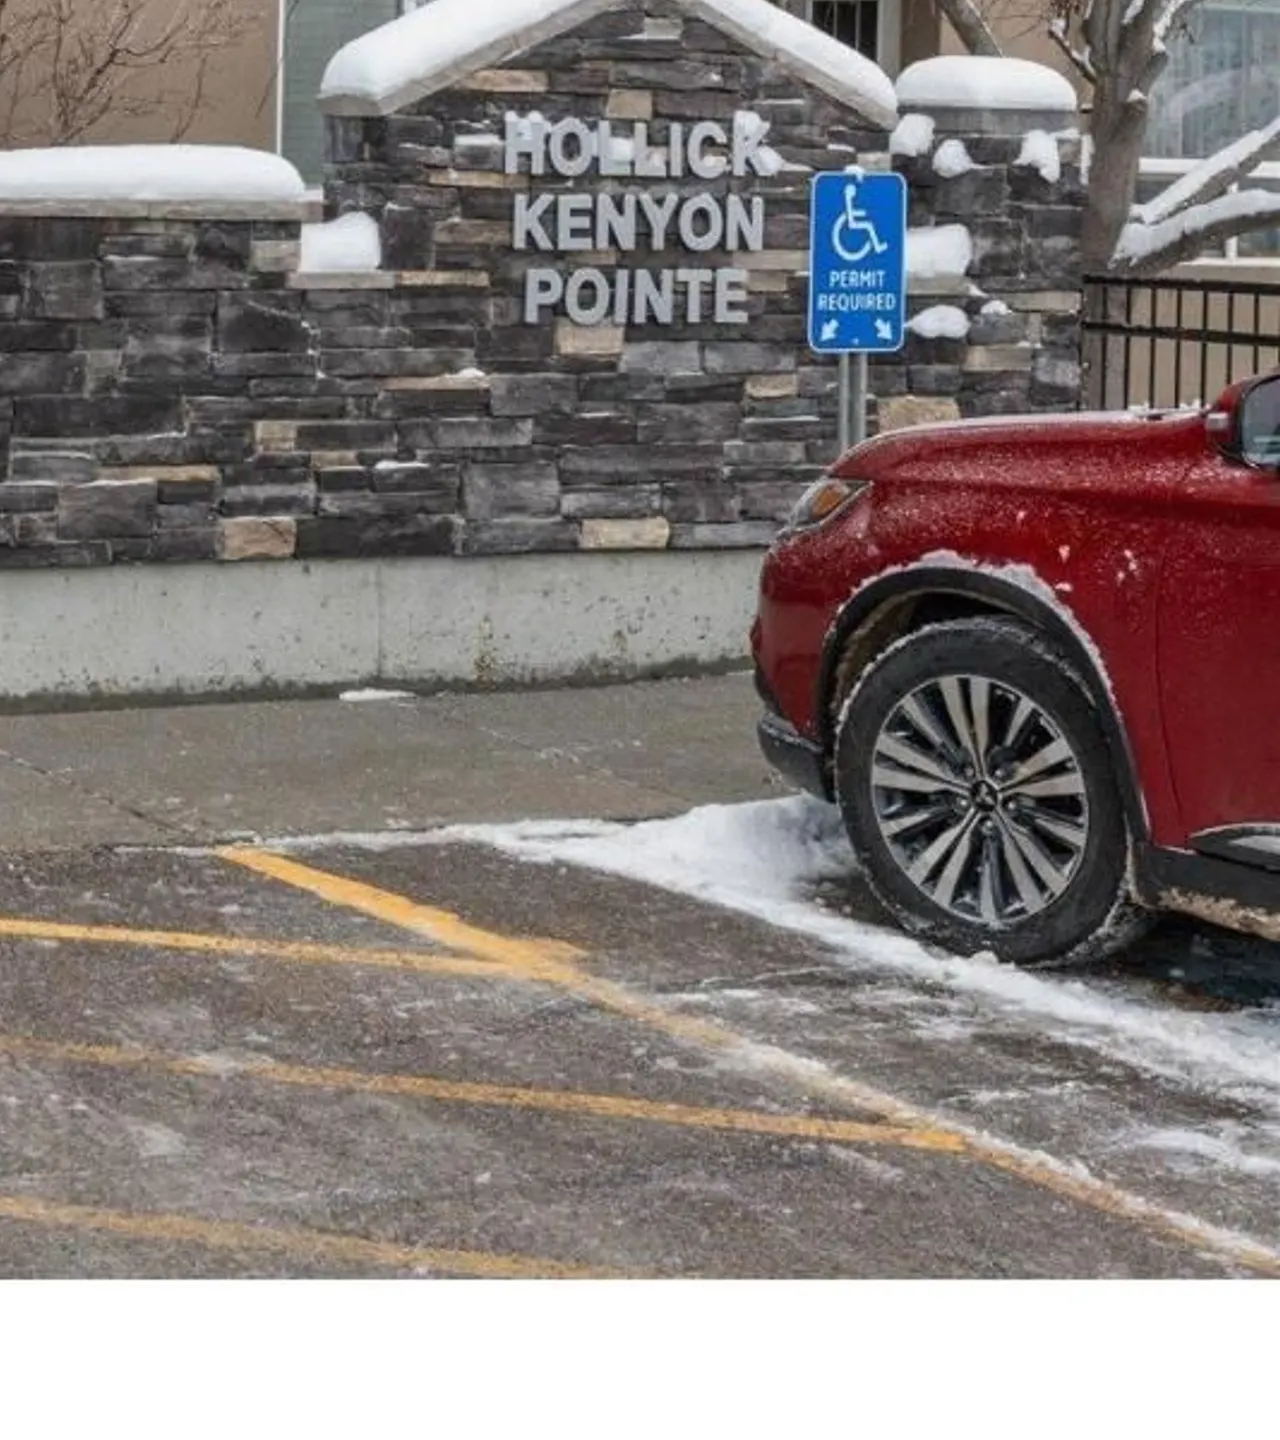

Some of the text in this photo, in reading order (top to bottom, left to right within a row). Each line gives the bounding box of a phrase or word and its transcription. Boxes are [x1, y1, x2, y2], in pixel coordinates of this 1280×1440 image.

[504, 111, 781, 179] HOLLICK
[513, 192, 765, 252] KENYON
[524, 267, 750, 327] POINTE
[817, 292, 897, 313] REQUIRED
[828, 270, 887, 289] PERMIT
